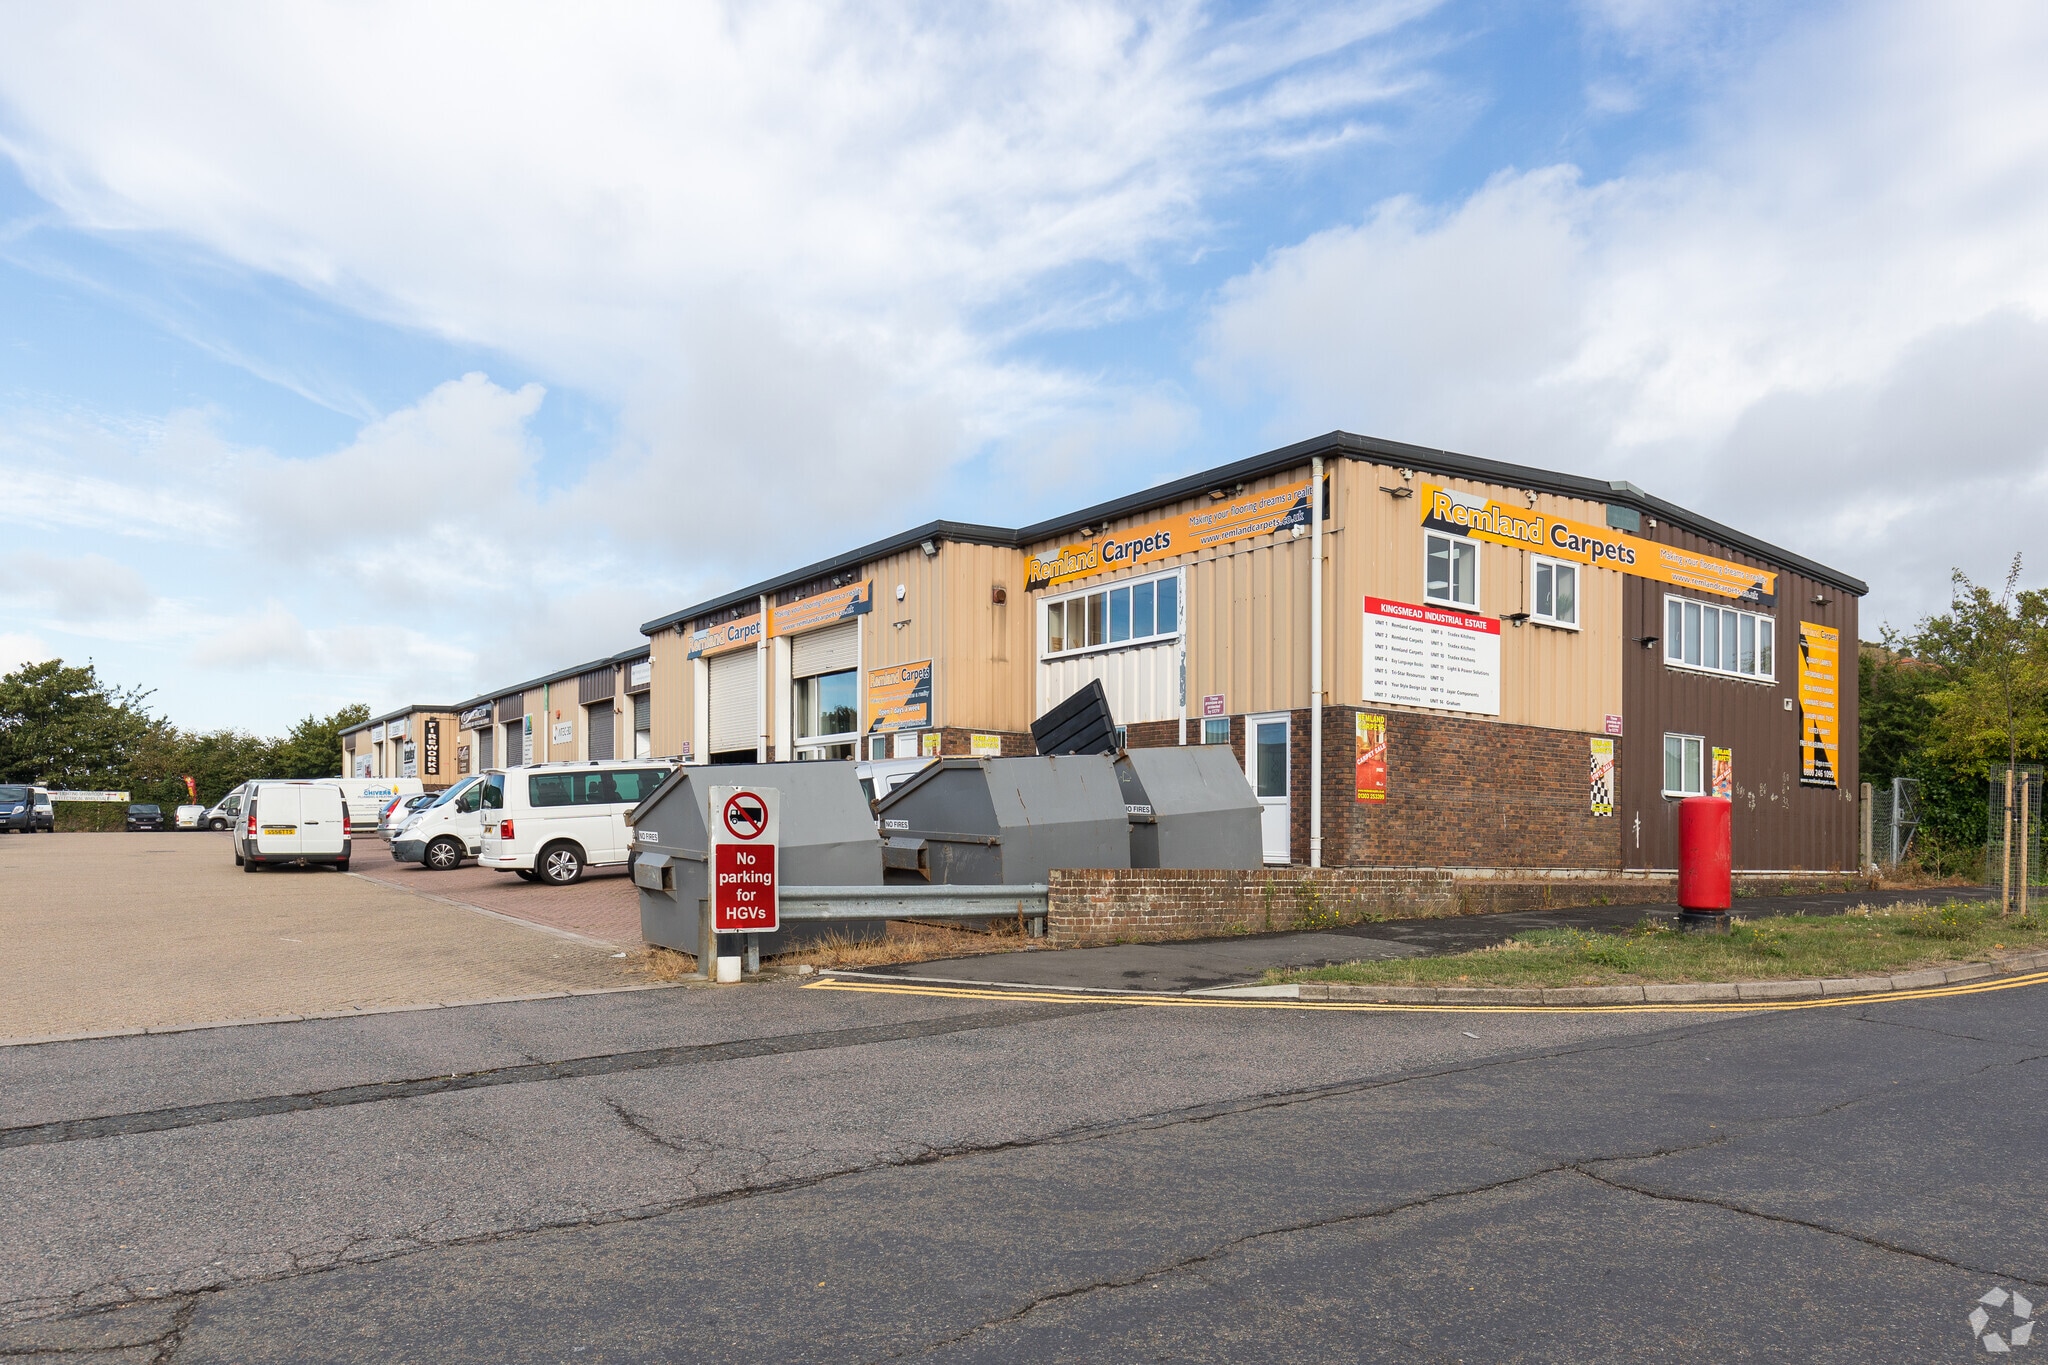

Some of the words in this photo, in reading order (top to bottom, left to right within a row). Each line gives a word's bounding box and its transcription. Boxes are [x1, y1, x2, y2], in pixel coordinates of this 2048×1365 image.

[1189, 513, 1213, 527] Making
[1213, 510, 1229, 524] your
[1230, 502, 1258, 516] flooring
[1259, 495, 1286, 509] dreams
[1293, 484, 1313, 499] realit
[1200, 510, 1305, 545] www.remlandcarpets.co.uk
[1432, 490, 1545, 545] Remland
[1550, 523, 1635, 565] Carpets
[1030, 543, 1098, 583] Remland
[1102, 529, 1172, 564] Carpets
[1660, 549, 1683, 566] Making
[1684, 557, 1699, 567] your
[1700, 558, 1722, 576] flooring
[1724, 565, 1745, 580] dreams
[1750, 573, 1769, 586] reality
[822, 594, 841, 604] dreams
[846, 587, 864, 597] reality
[1672, 572, 1759, 600] www.remlandcarpets.co.uk
[1381, 604, 1422, 618] KINGSMEAD
[1425, 612, 1463, 626] INDUSTRIAL
[1465, 618, 1487, 630] ESTATE
[688, 626, 726, 653] Remland
[728, 621, 760, 642] Carpet
[1409, 625, 1423, 633] Carpets
[870, 668, 900, 688] Remland
[902, 667, 930, 684] Carpets
[1357, 713, 1384, 723] REMLAND
[1358, 721, 1385, 733] CARPETS
[426, 722, 438, 773] FIREWORKS
[1357, 750, 1374, 765] CARPET
[1375, 742, 1387, 753] SALE
[646, 833, 657, 841] FIRES
[737, 852, 756, 865] No
[720, 871, 772, 886] parking
[736, 889, 756, 901] for
[726, 907, 766, 920] HGVs
